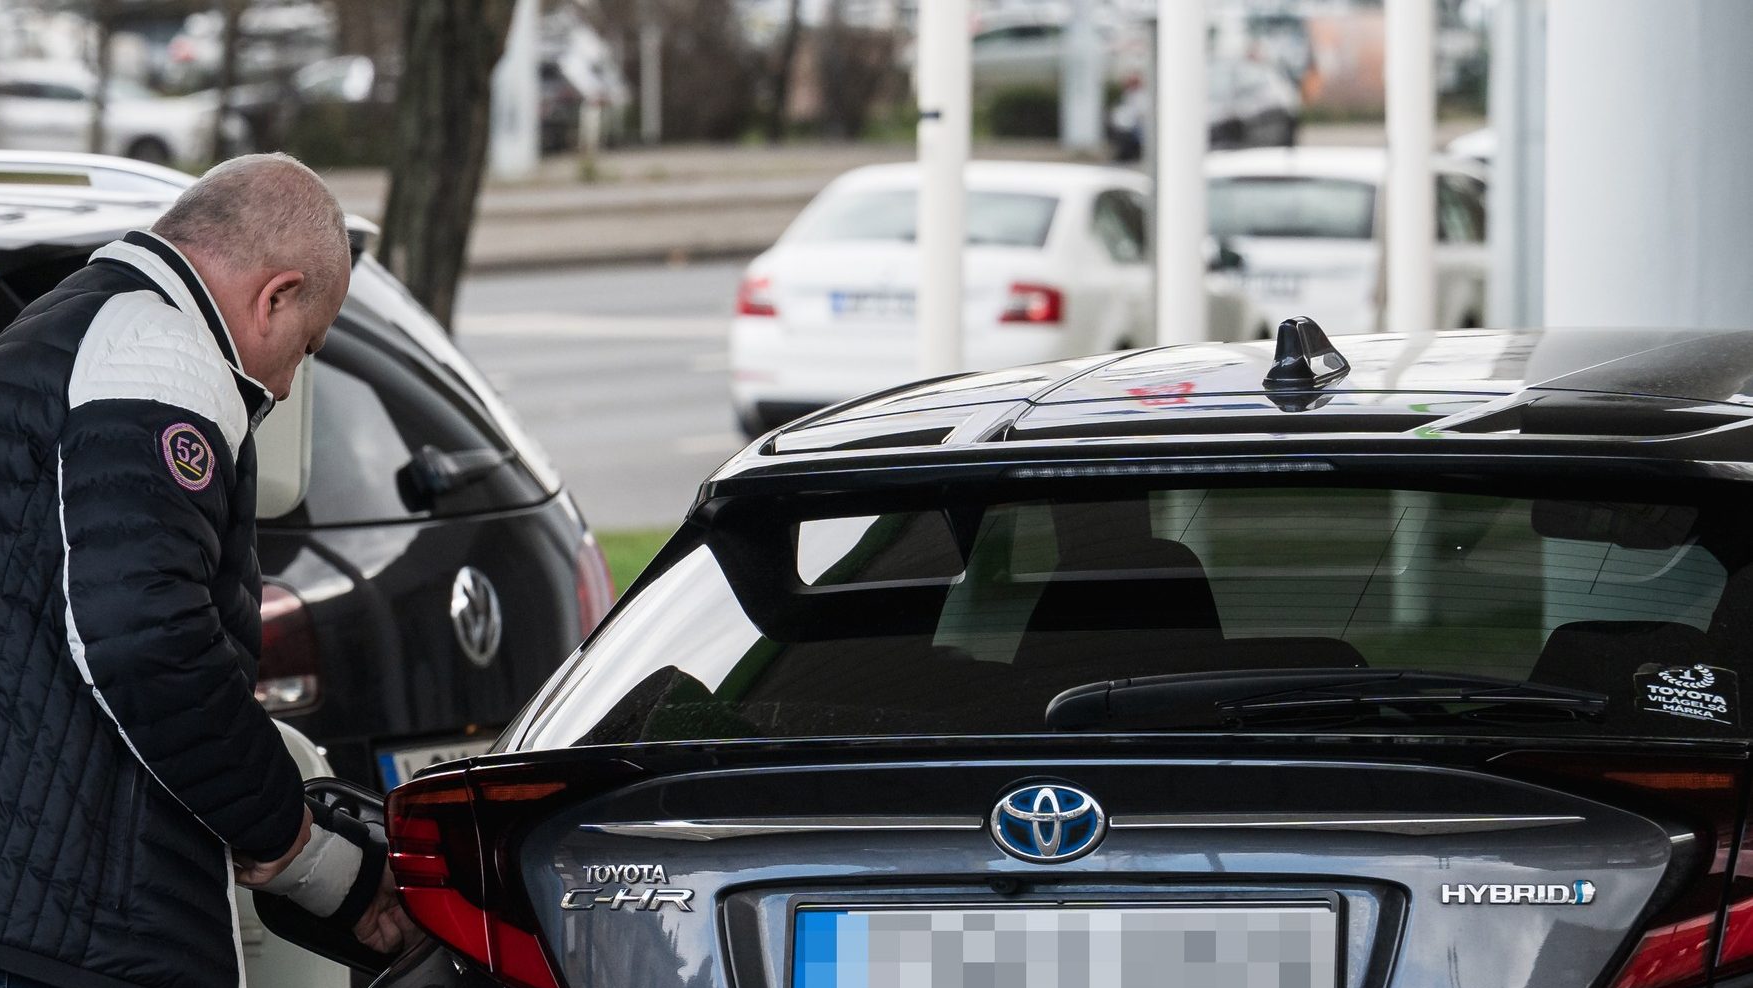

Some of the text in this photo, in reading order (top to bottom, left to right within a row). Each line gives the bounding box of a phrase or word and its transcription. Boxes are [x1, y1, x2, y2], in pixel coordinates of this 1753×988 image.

[176, 436, 205, 472] 52
[1647, 685, 1727, 706] TOYOTA
[1648, 694, 1727, 713] VILÁGELSŐ
[1663, 704, 1714, 718] MÁRKA
[583, 864, 670, 884] TOYOTA
[560, 887, 695, 912] C-HR
[1441, 884, 1570, 904] HYBRID
